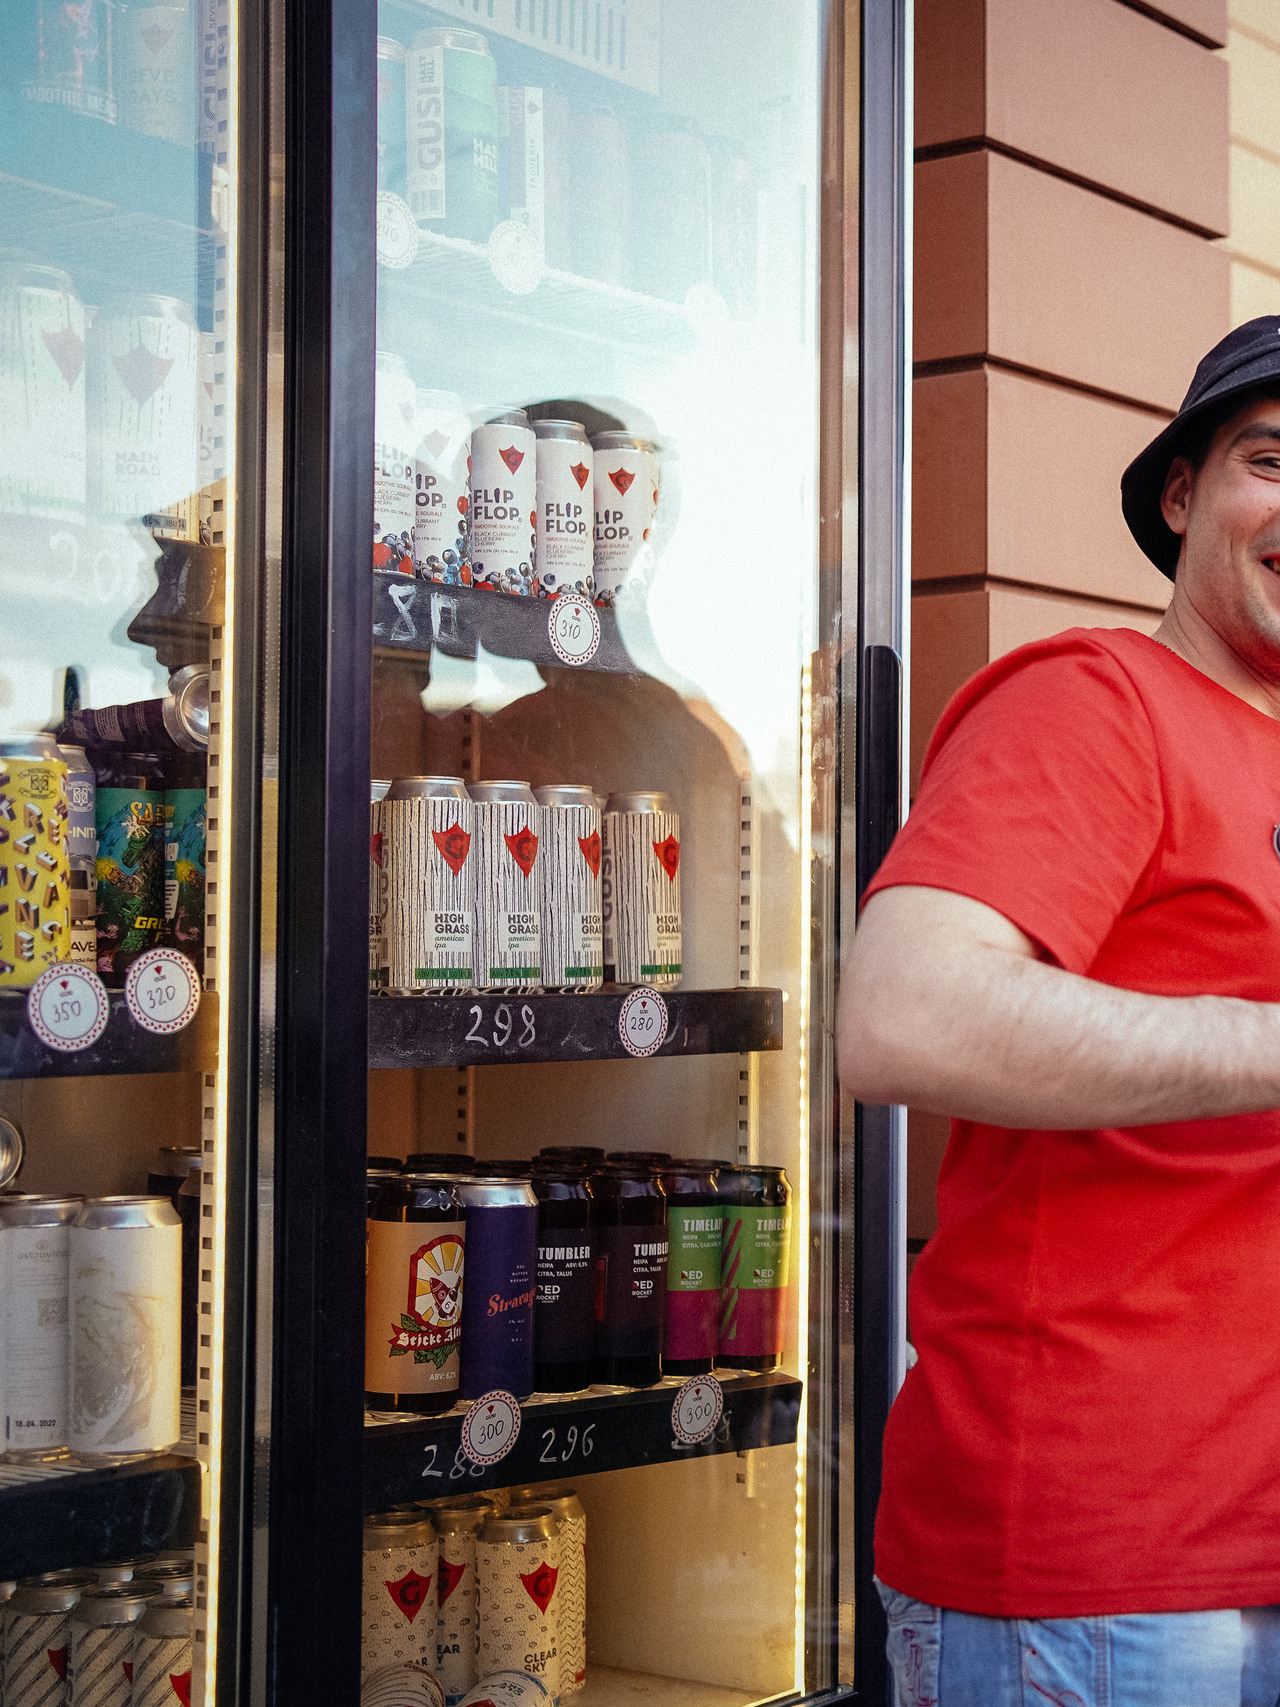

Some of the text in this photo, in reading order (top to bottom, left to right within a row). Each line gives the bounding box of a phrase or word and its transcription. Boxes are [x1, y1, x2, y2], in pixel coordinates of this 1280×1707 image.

[417, 87, 443, 171] GUSI
[473, 506, 520, 520] FLOP
[545, 519, 587, 535] FLOP
[560, 620, 581, 639] 310
[445, 834, 463, 860] G
[516, 837, 532, 861] G
[434, 913, 464, 924] HIGH
[507, 914, 535, 924] HIGH
[656, 915, 679, 924] HIGH
[434, 924, 470, 934] GRASS
[508, 924, 539, 935] GRASS
[147, 985, 176, 1009] 320
[52, 1000, 81, 1023] 350
[465, 1003, 536, 1048] 298
[630, 1016, 654, 1031] 280
[538, 1246, 591, 1260] TUMBLER
[686, 1402, 713, 1424] 300
[478, 1419, 505, 1444] 300
[539, 1423, 596, 1463] 296
[399, 1580, 420, 1606] G
[524, 1647, 557, 1664] CLEAR
[524, 1660, 547, 1673] SKY
